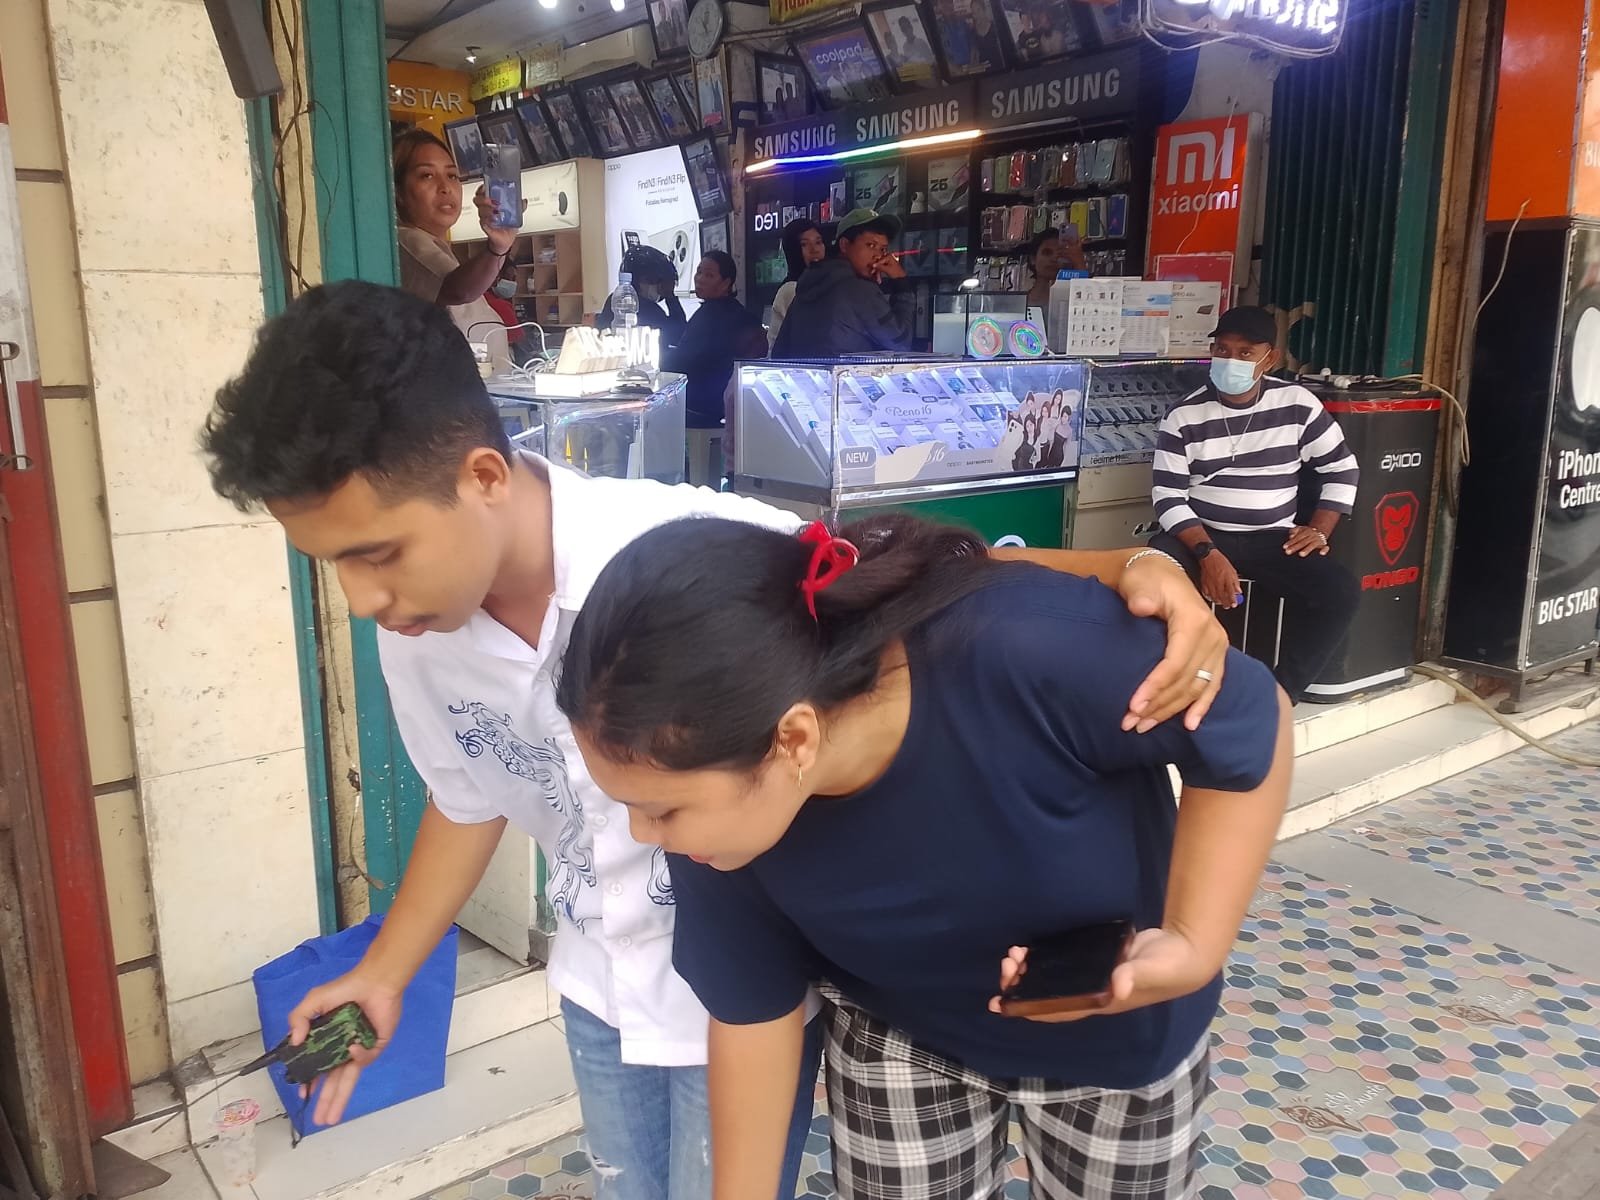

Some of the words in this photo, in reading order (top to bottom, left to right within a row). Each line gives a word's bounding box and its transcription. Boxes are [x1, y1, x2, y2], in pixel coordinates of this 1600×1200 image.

[815, 42, 862, 65] coolpad
[991, 67, 1120, 119] SAMSUNG
[857, 99, 959, 143] SAMSUNG
[754, 123, 836, 160] SAMSUNG
[1157, 183, 1239, 215] xiaomi
[845, 452, 869, 464] NEW
[1560, 482, 1600, 509] Centre
[1538, 596, 1565, 625] BIG
[1564, 587, 1599, 618] STAR
